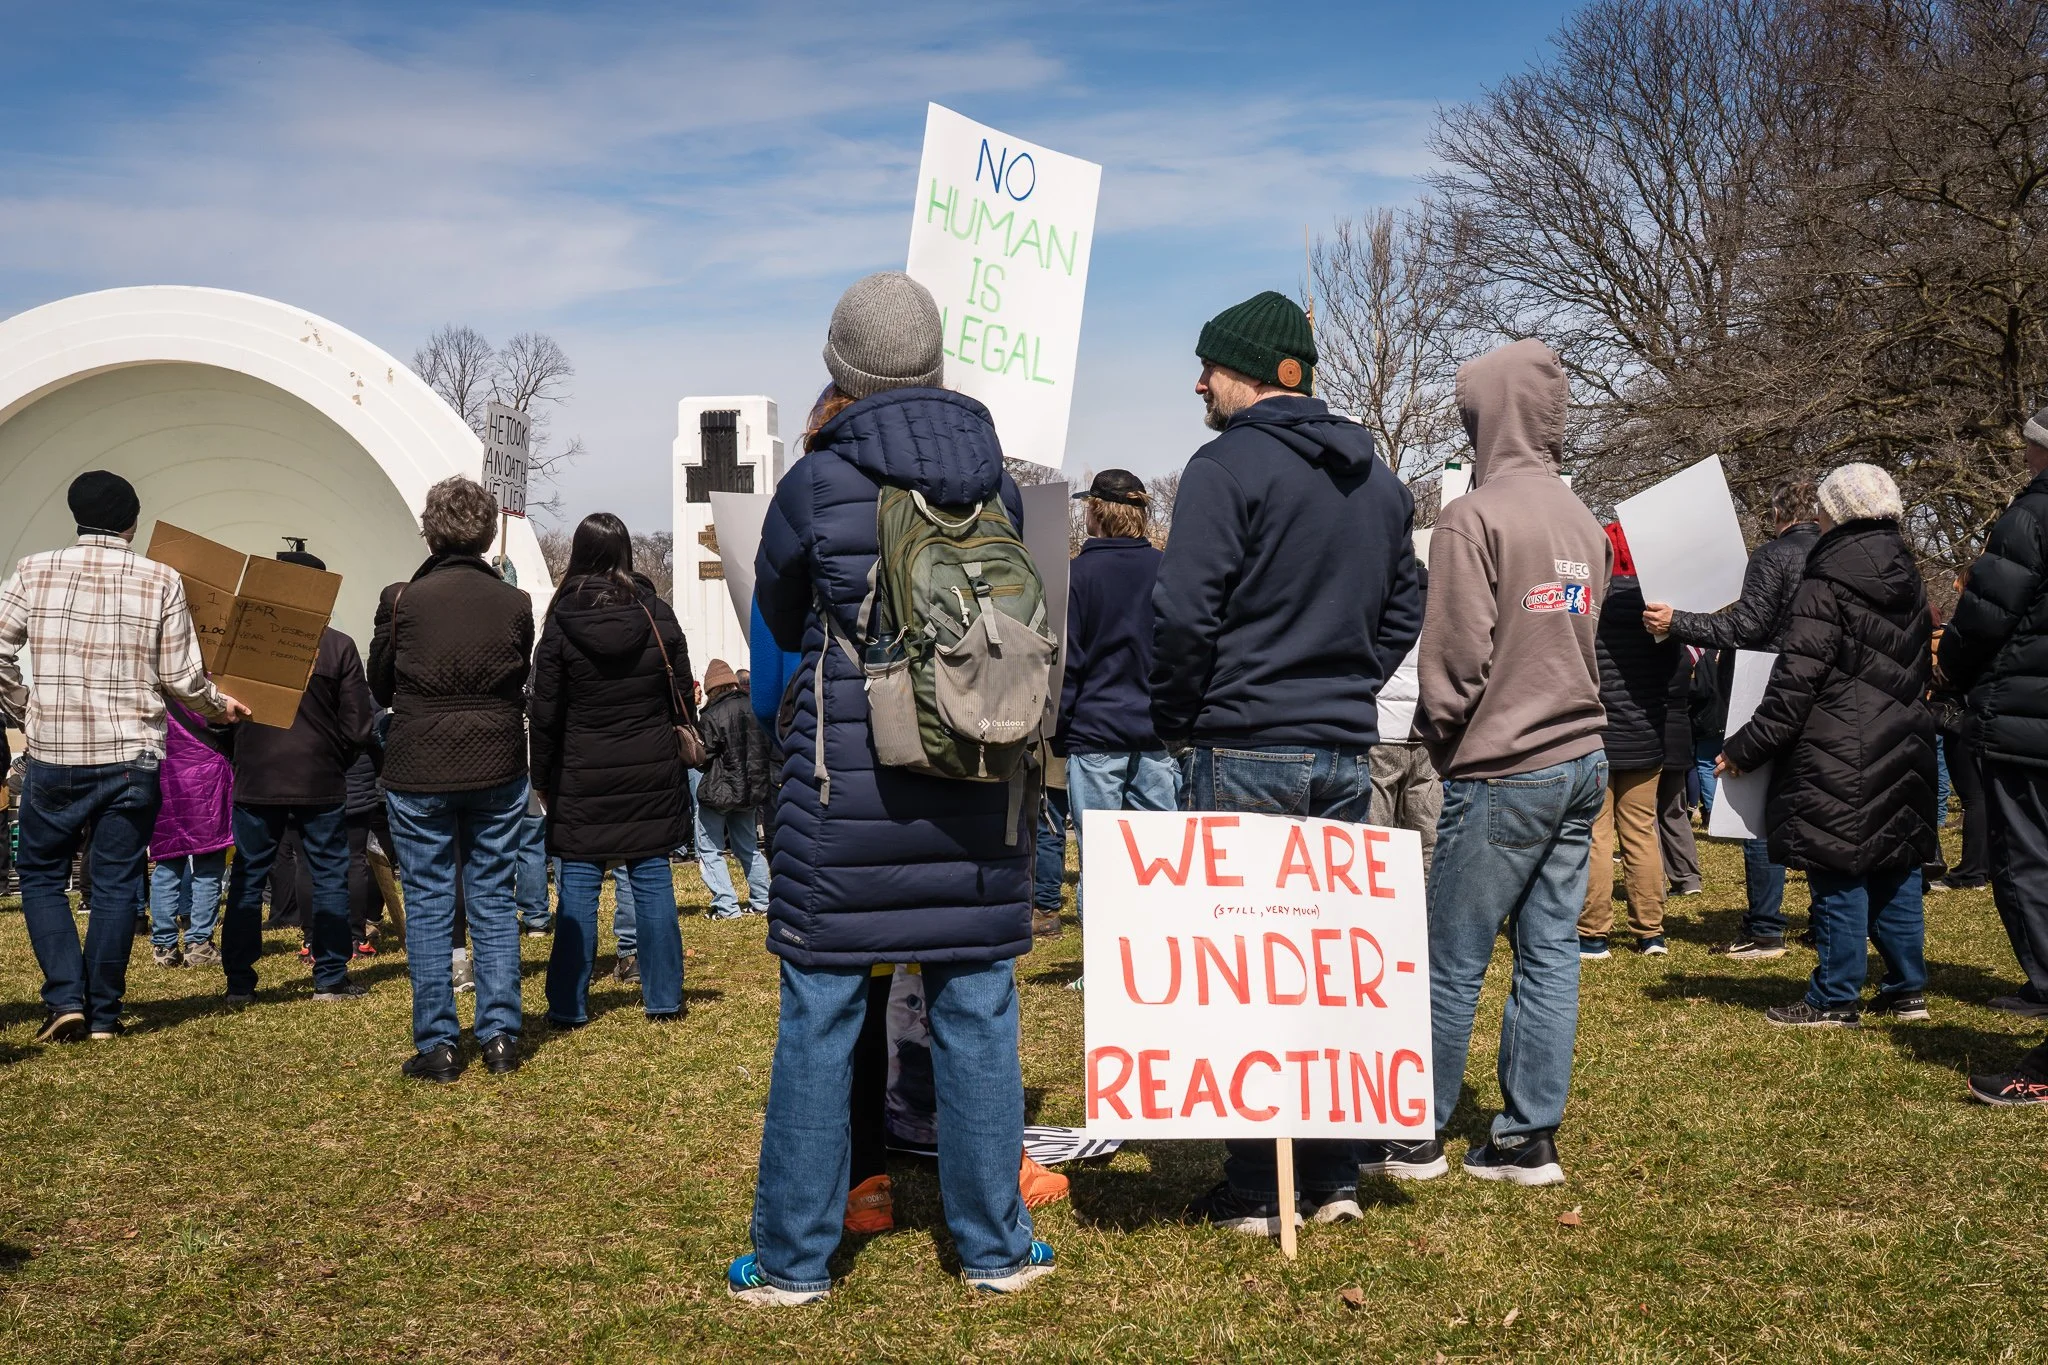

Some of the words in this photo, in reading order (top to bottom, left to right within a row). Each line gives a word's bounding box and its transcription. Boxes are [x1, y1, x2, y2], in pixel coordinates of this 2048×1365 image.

[976, 138, 1036, 201] NO
[928, 177, 1078, 276] HUMAN
[967, 257, 1006, 313] IS
[942, 306, 1056, 386] LEGAL
[488, 412, 504, 445] HE
[505, 415, 528, 451] TOOK
[484, 446, 504, 476] AN
[207, 592, 220, 606] 1
[236, 600, 278, 620] YEAR
[219, 613, 254, 628] HAS
[199, 624, 226, 636] 200
[991, 719, 1026, 728] Outdoor
[1117, 816, 1244, 887] WE
[1276, 825, 1396, 899] ARE
[1266, 905, 1290, 915] VERY
[1292, 904, 1320, 919] MUCH)
[1118, 927, 1416, 1009] UNDER-
[1087, 1045, 1426, 1127] REACTING
